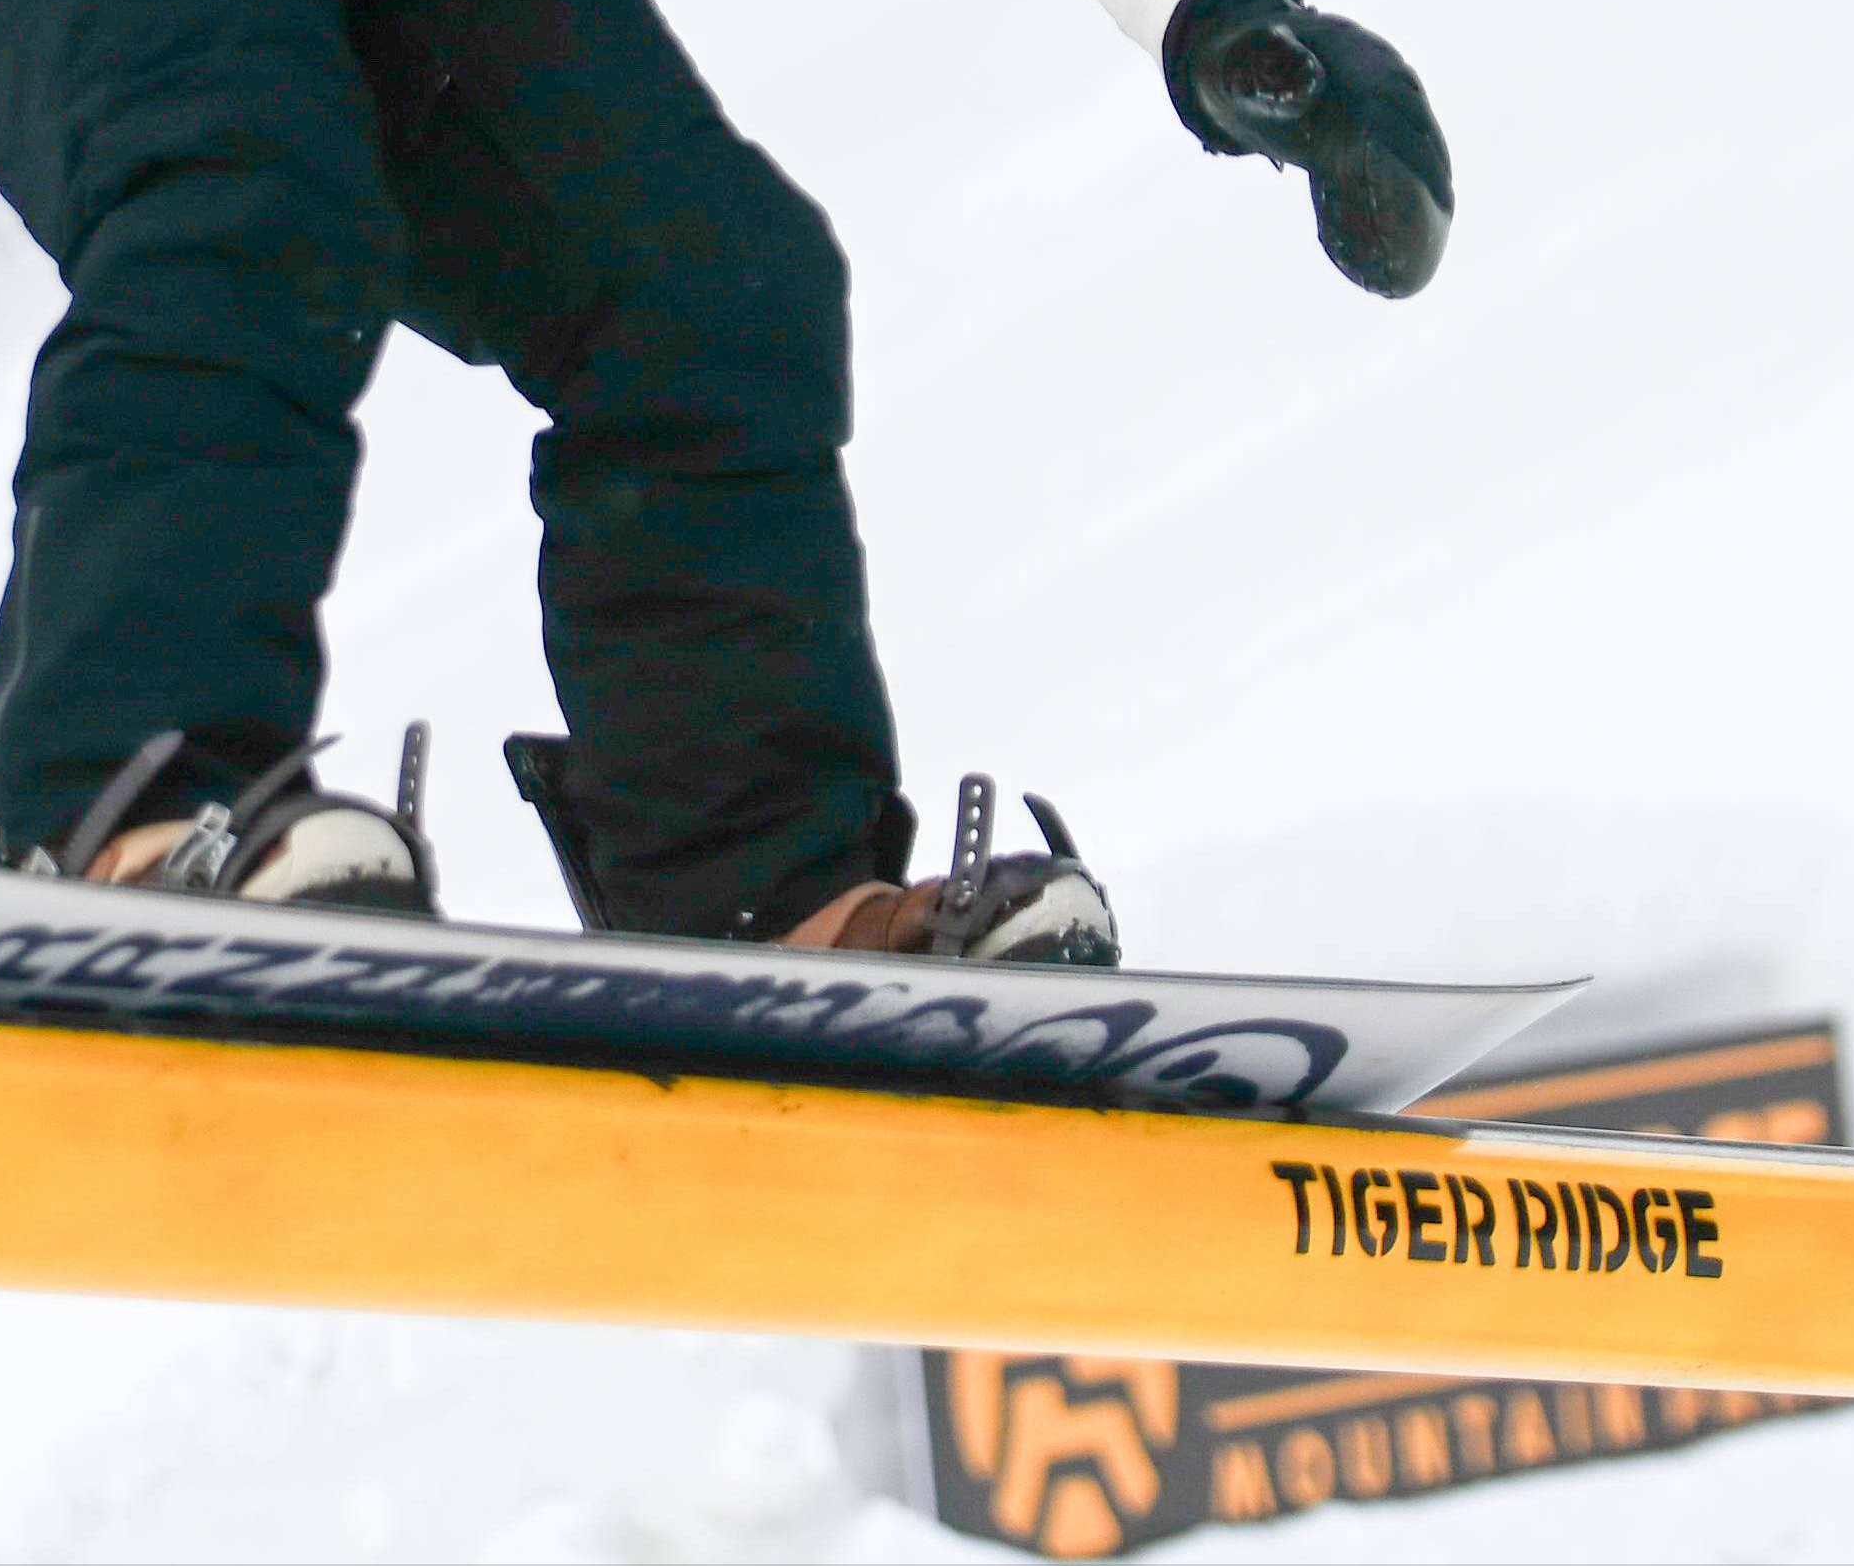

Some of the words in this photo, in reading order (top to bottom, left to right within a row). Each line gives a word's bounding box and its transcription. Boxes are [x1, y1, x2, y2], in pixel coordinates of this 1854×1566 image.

[1270, 1159, 1497, 1268] TIGER
[1506, 1176, 1725, 1280] RIDGE
[1207, 1384, 1649, 1524] MOUNTAIN
